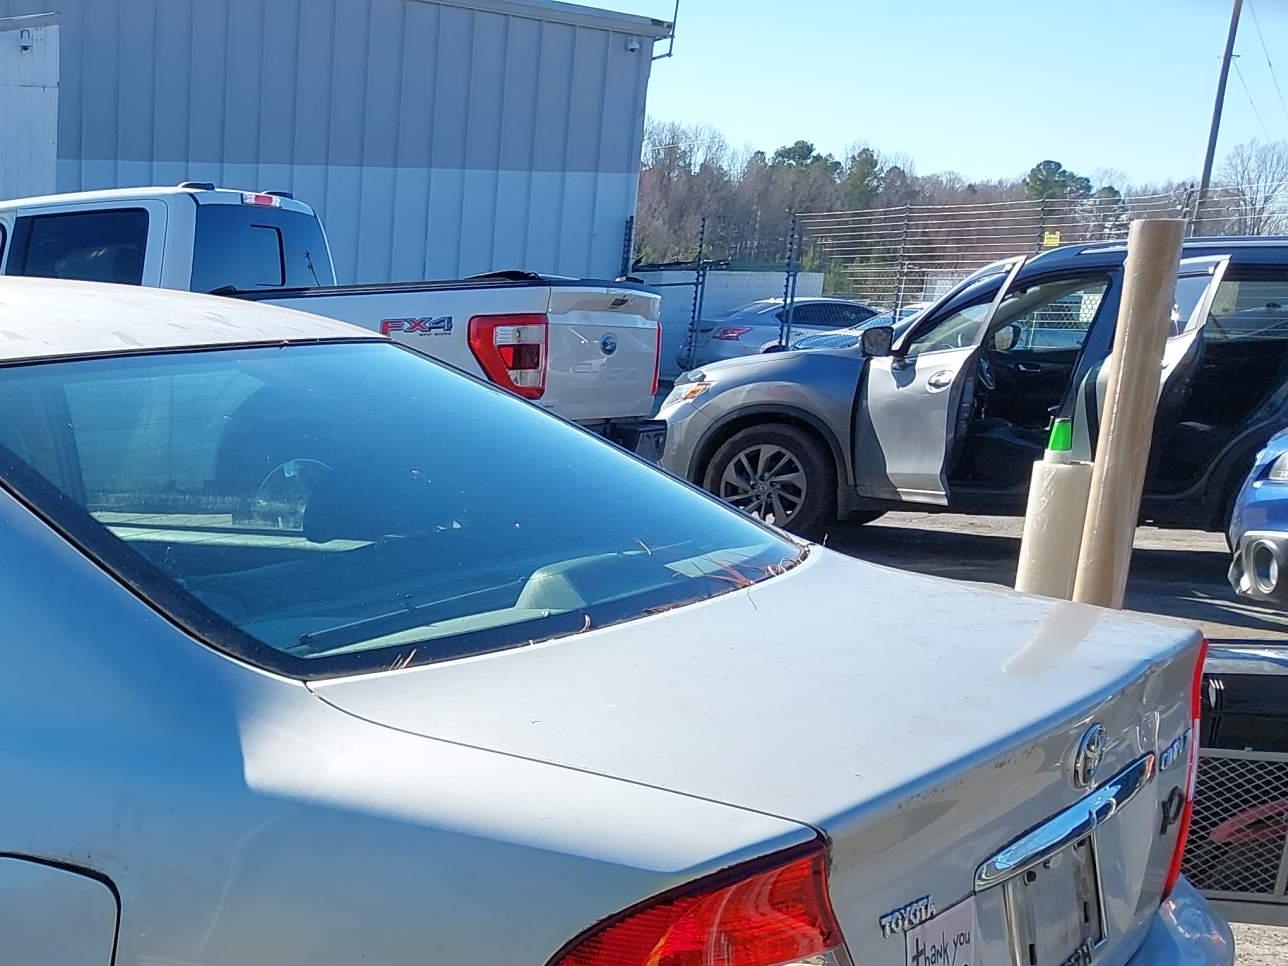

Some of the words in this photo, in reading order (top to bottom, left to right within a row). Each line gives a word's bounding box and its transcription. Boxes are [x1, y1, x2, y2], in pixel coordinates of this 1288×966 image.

[380, 316, 453, 337] FX4
[879, 895, 936, 938] TOYOTA
[952, 931, 971, 966] you
